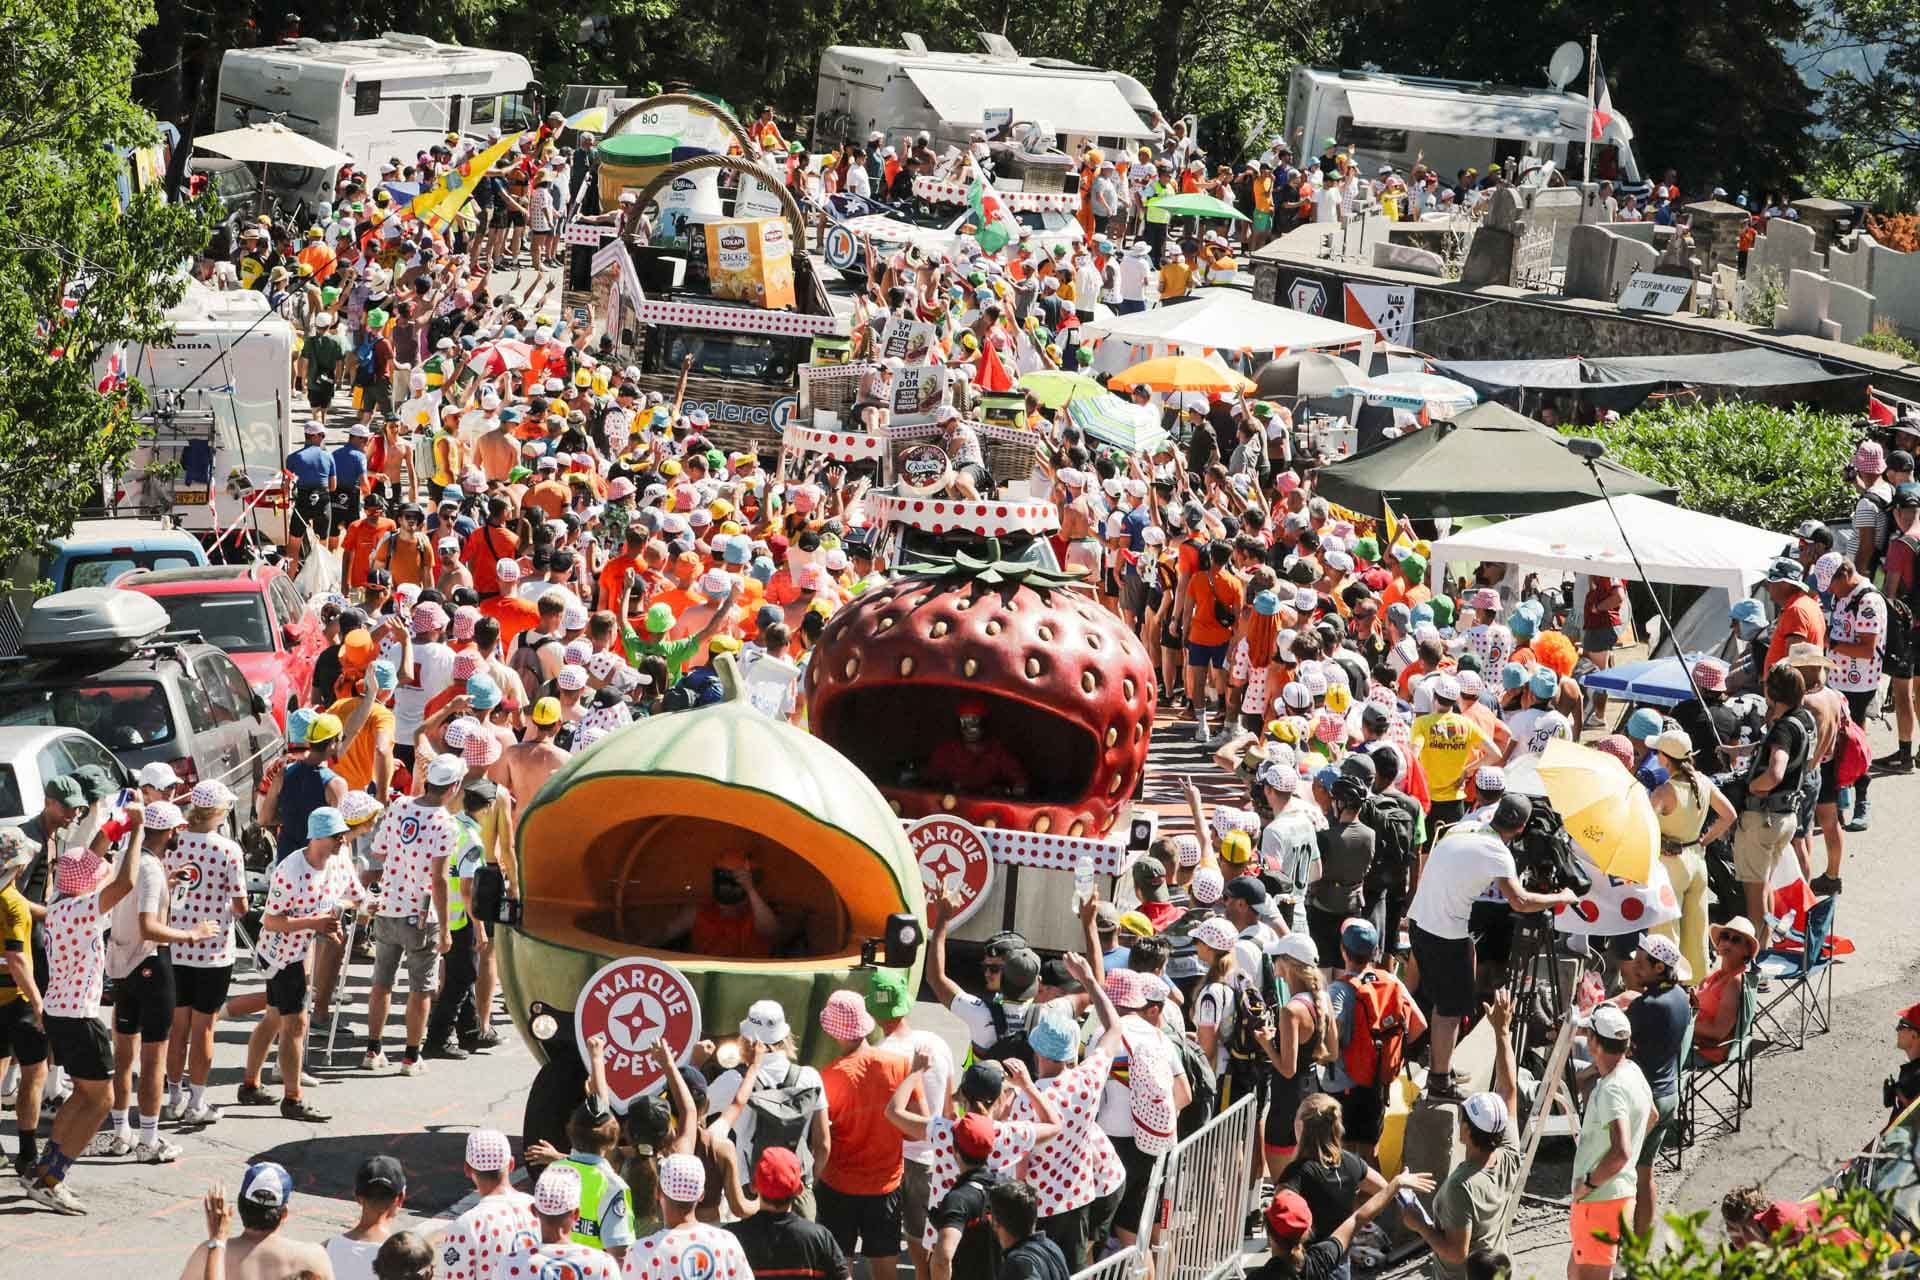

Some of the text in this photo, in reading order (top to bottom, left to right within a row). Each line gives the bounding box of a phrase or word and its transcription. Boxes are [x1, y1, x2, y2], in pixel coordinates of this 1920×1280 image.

[682, 400, 768, 425] eclerc
[911, 826, 983, 863] MARQUE
[594, 969, 688, 1017] MARQUE
